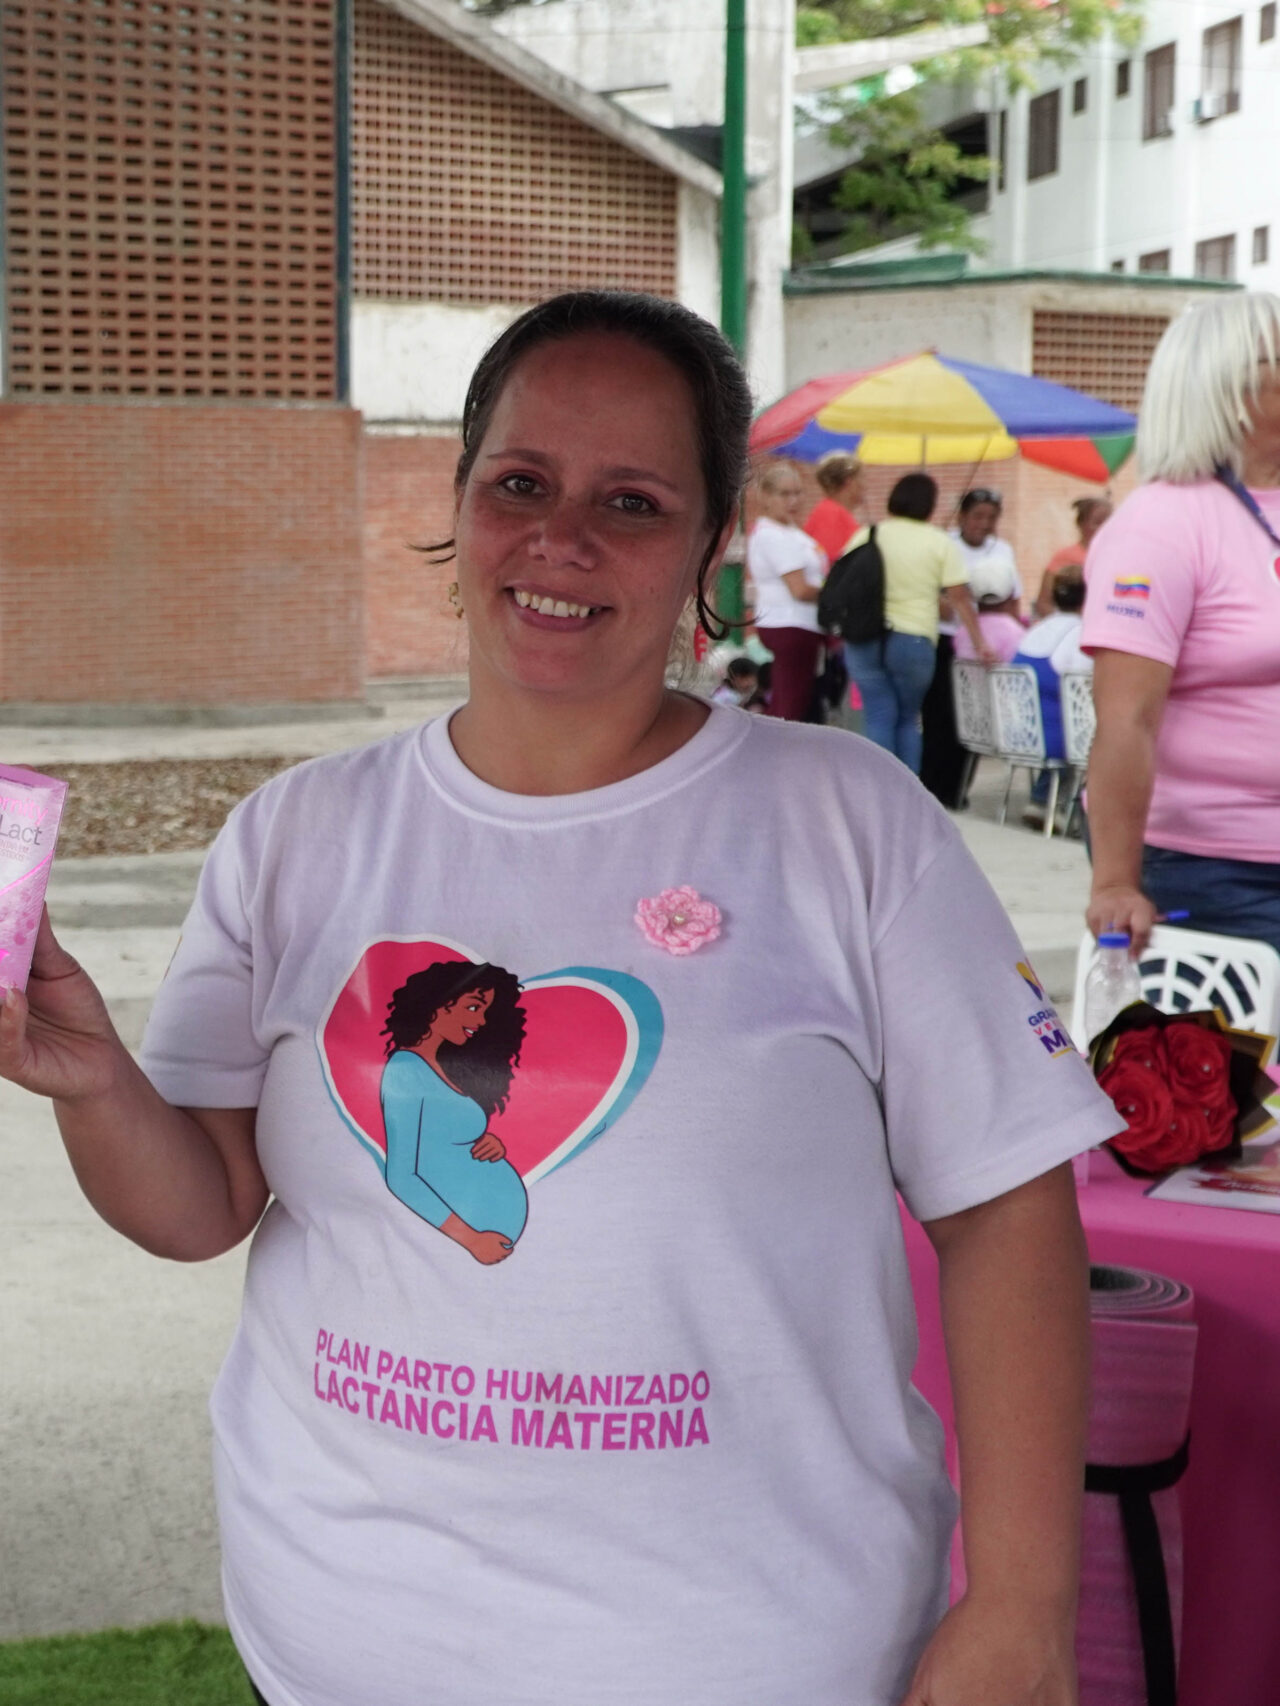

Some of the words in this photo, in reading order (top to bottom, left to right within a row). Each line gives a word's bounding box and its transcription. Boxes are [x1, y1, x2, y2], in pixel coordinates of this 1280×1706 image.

[314, 1362, 499, 1443] LACTANCIA
[511, 1407, 710, 1451] MATERNA
[316, 1328, 370, 1375] PLAN
[377, 1349, 476, 1396] PARTO
[486, 1368, 710, 1406] HUMANIZADO
